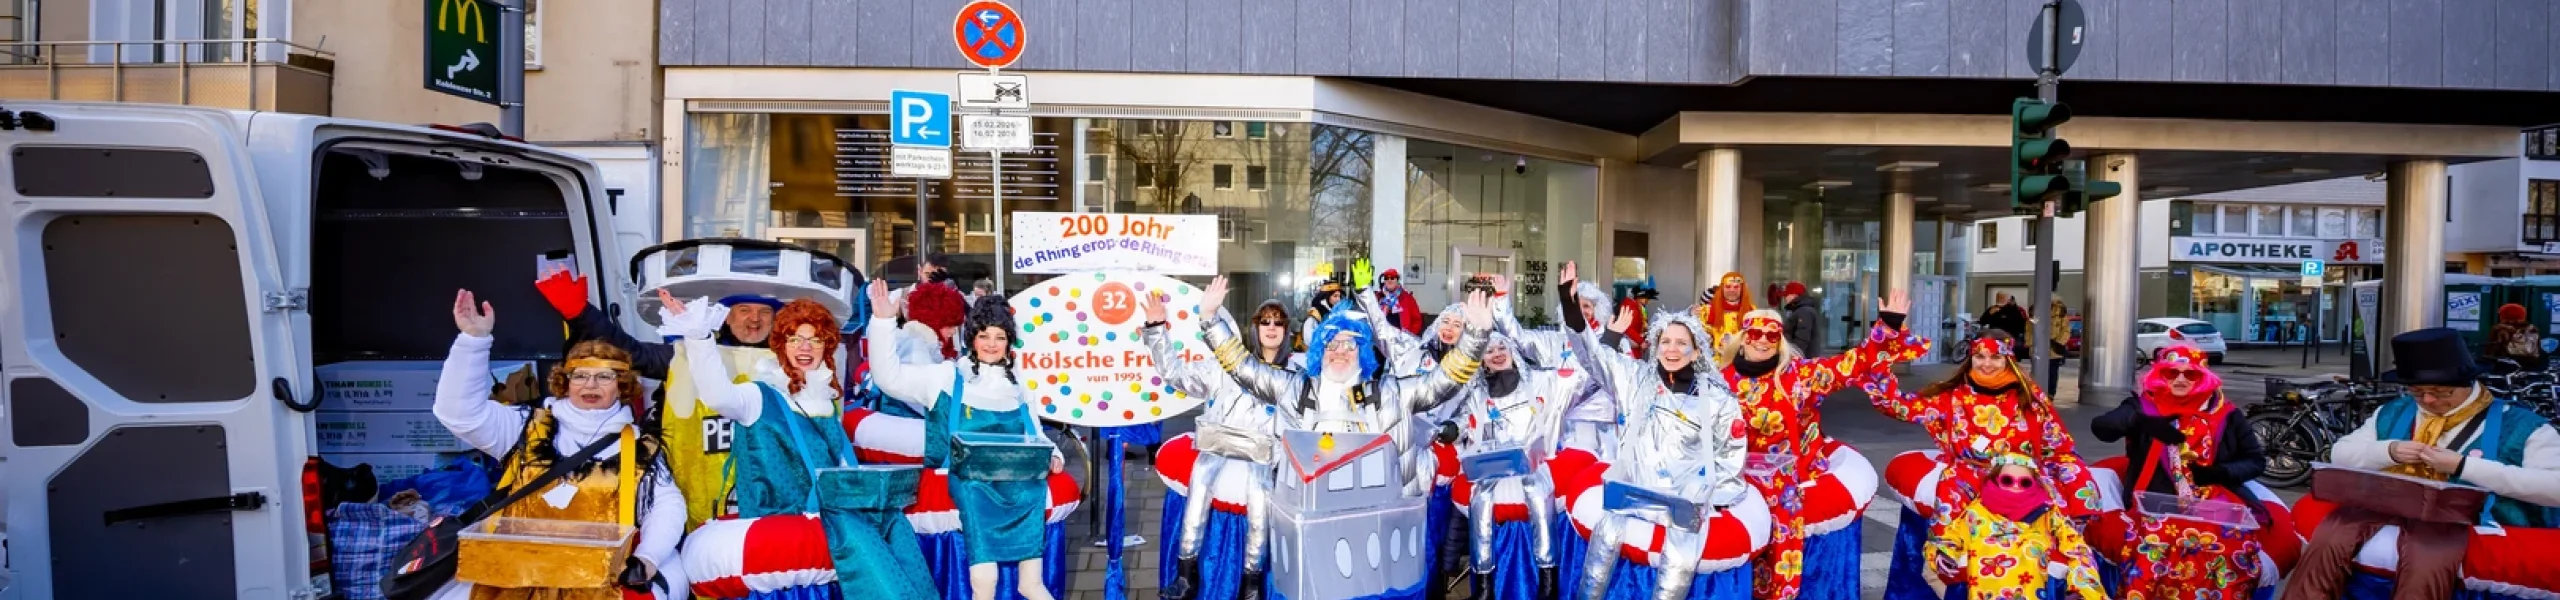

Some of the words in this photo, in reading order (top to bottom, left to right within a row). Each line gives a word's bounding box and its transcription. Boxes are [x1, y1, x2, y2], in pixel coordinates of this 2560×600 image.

[902, 97, 933, 138] P
[1060, 215, 1109, 239] 200
[1119, 215, 1175, 240] Johr
[1014, 255, 1034, 270] de
[1035, 244, 1081, 264] Rhing
[1119, 237, 1140, 251] de
[1141, 240, 1182, 264] Rhing
[2189, 242, 2313, 259] APOTHEKE
[1102, 290, 1127, 309] 32
[1022, 350, 1114, 369] Kölsche
[1113, 372, 1142, 382] 1995
